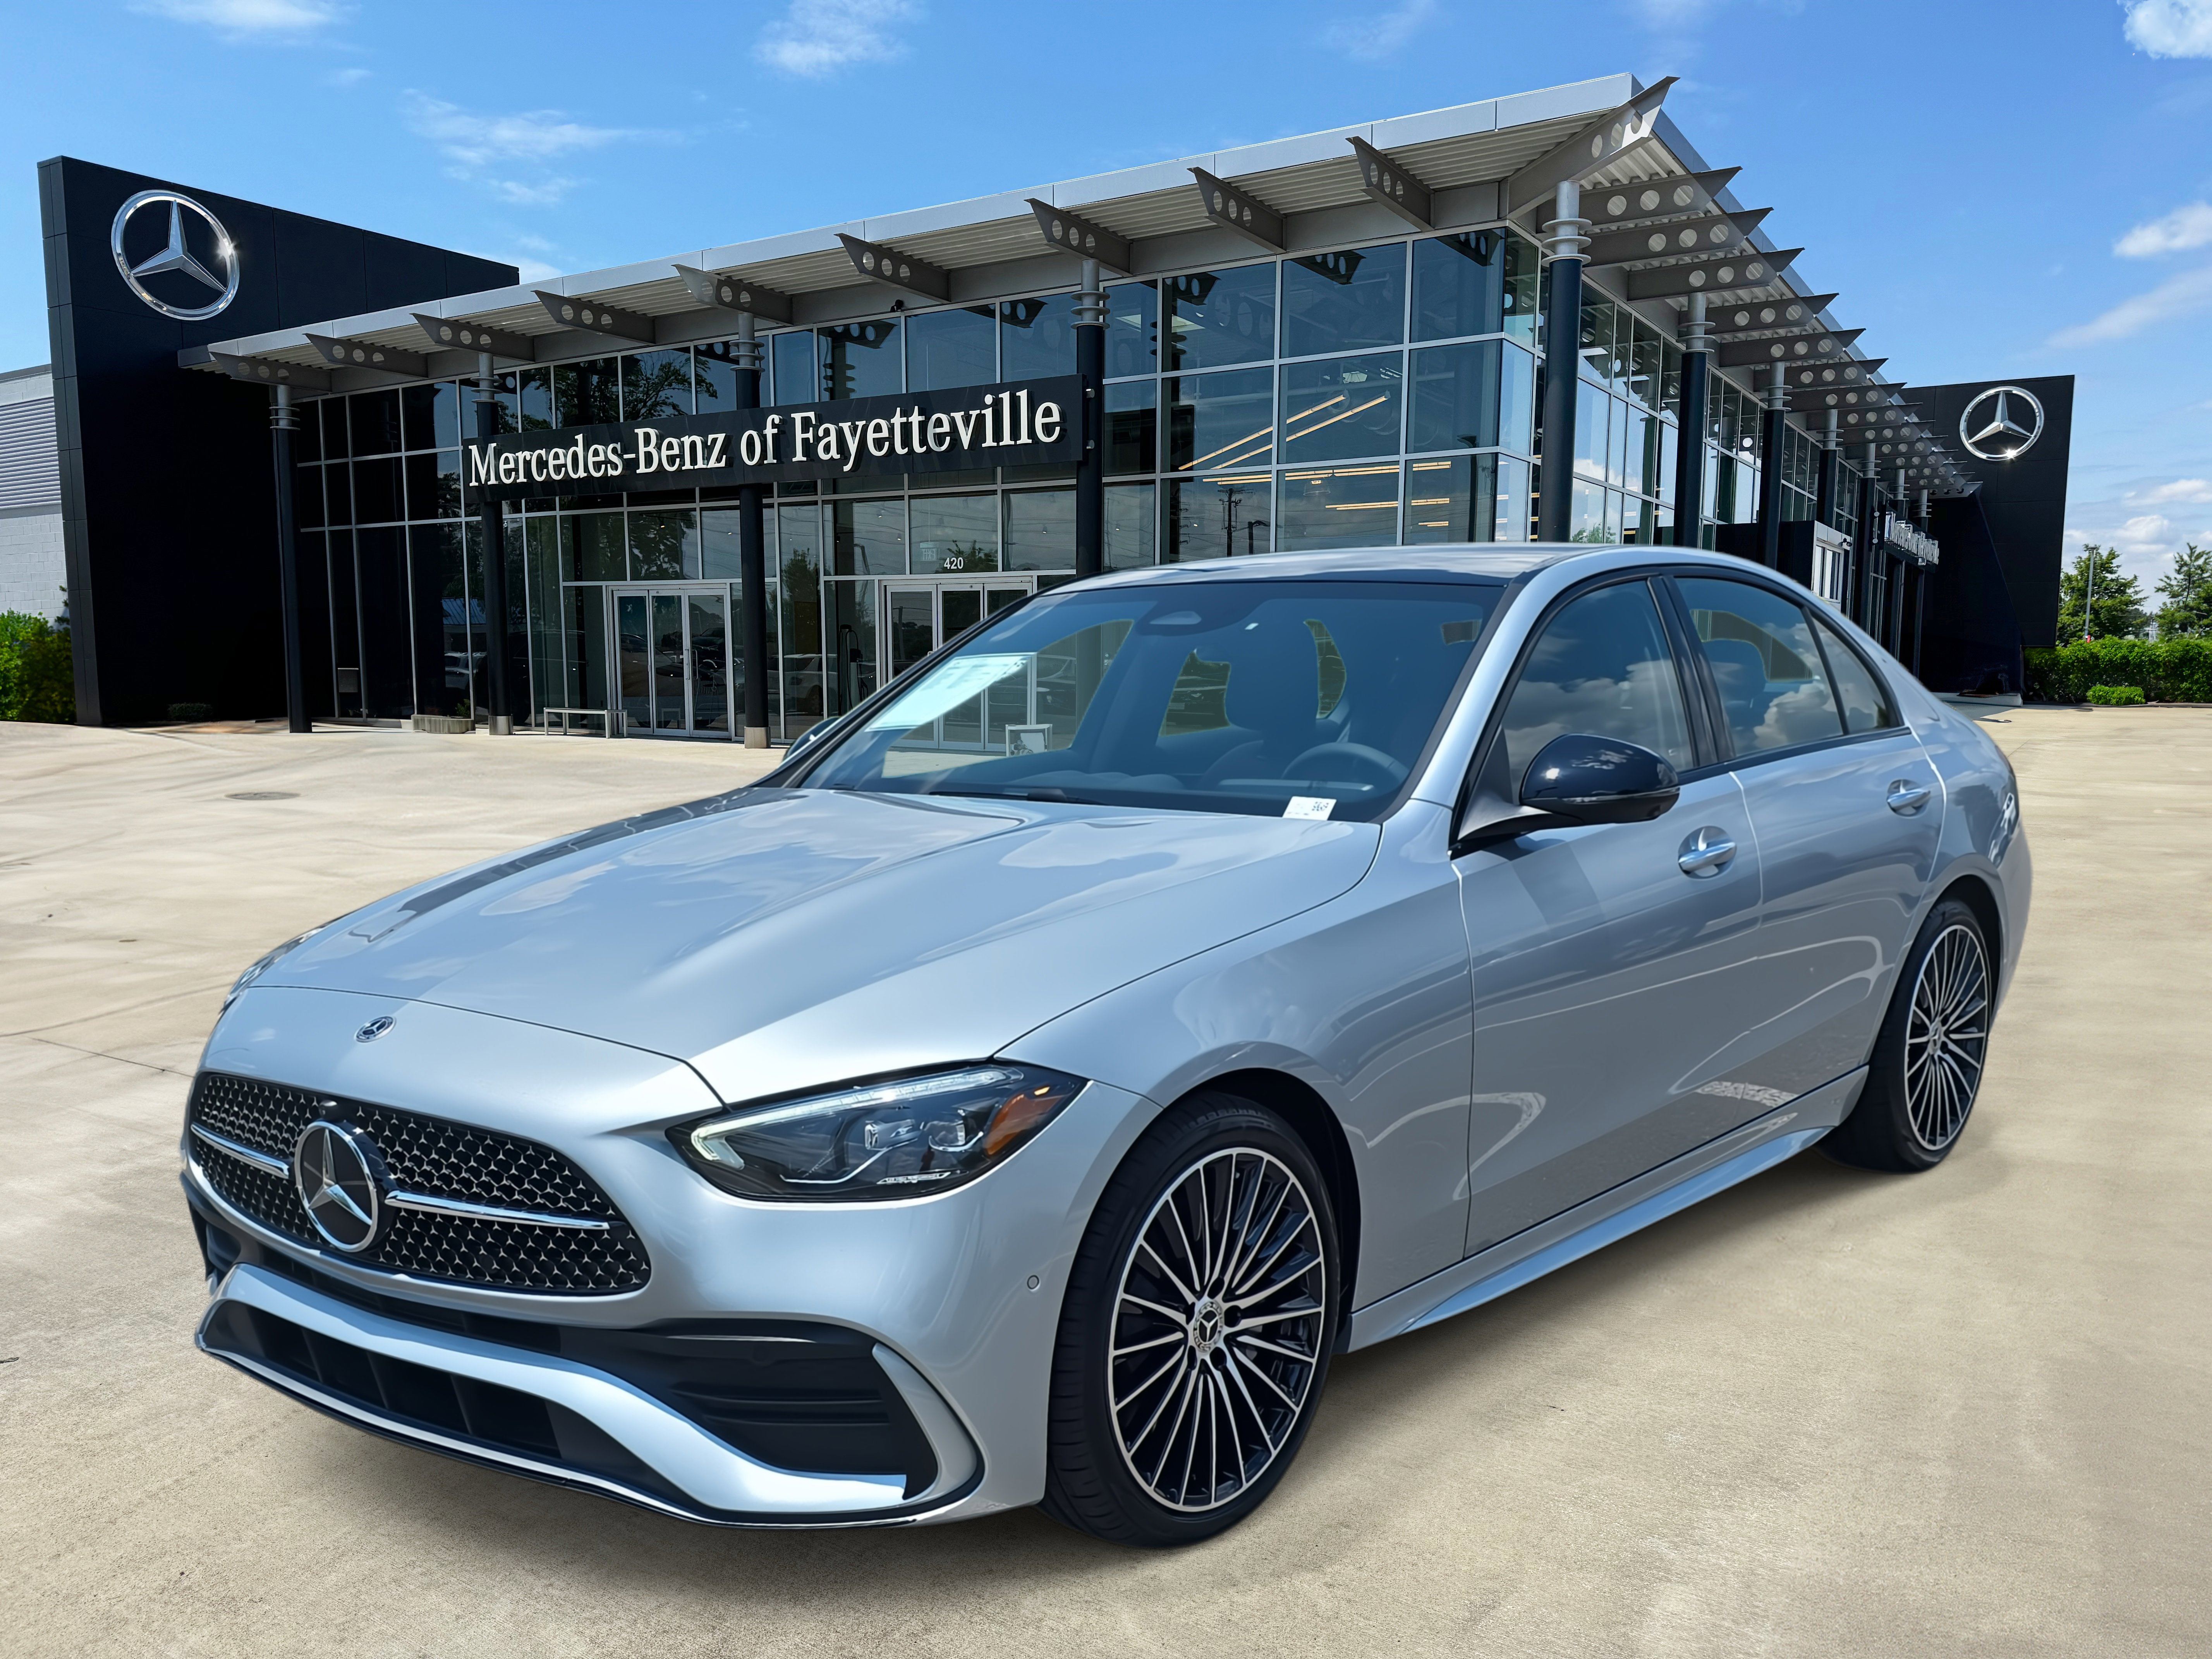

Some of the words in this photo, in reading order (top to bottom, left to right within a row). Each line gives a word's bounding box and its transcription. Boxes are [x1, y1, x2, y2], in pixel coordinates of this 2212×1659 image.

[468, 428, 726, 487] Mercedes-Benz
[740, 414, 782, 465] of
[791, 389, 1060, 472] Fayetteville
[944, 557, 963, 569] 420
